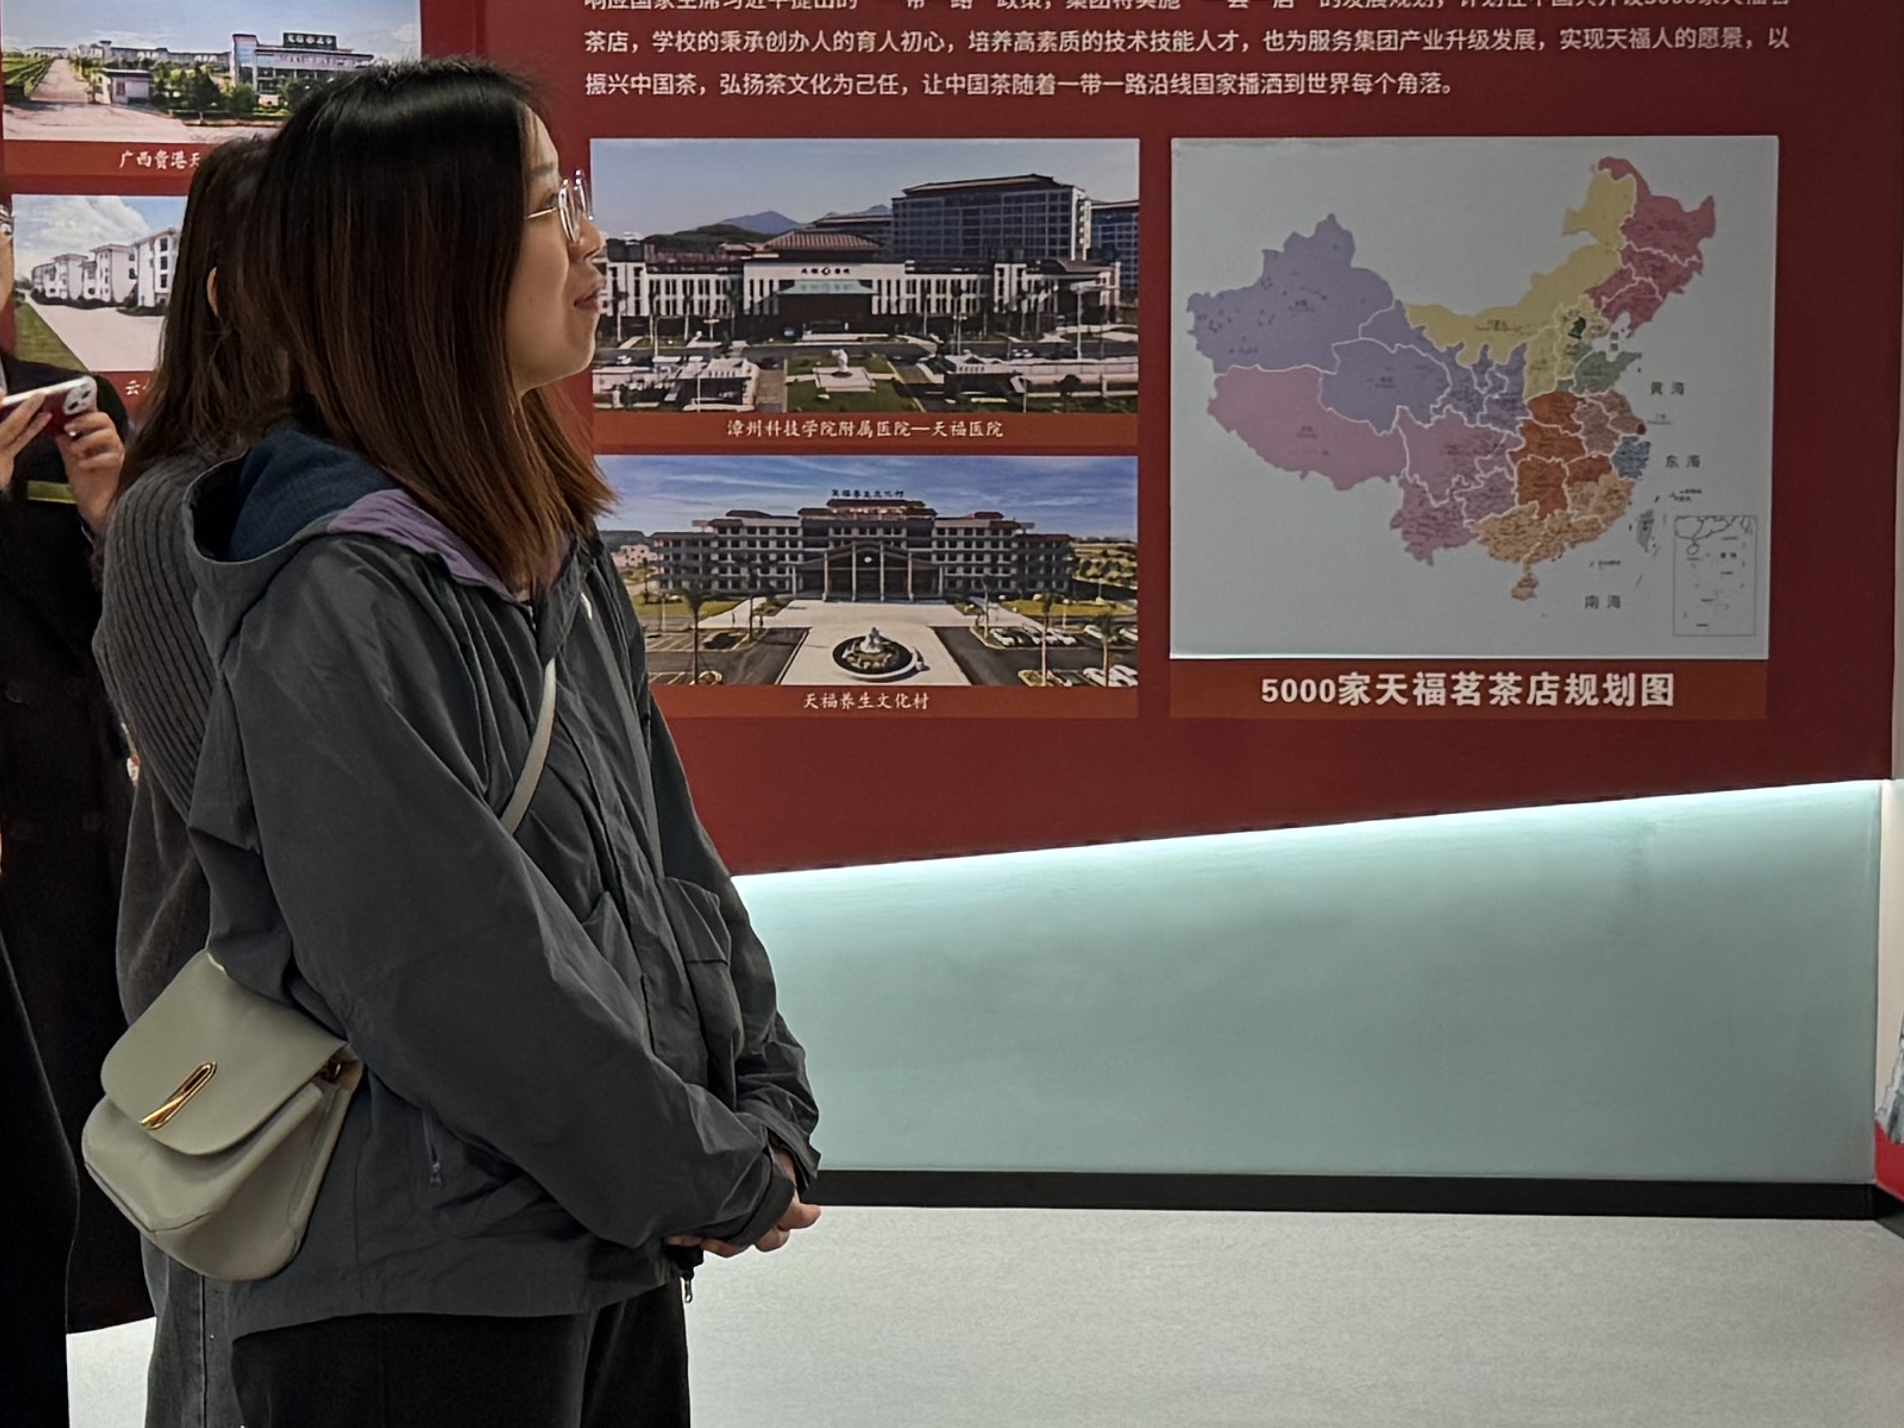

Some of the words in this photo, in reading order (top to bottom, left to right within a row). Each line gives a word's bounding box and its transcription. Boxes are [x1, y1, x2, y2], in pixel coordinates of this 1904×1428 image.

[1649, 380, 1686, 396] 黄海
[1664, 454, 1702, 469] 东海
[1583, 594, 1623, 610] 南海
[1260, 670, 1675, 707] 5000家天福茗茶店规划图
[802, 690, 930, 710] 天福养生文化村
